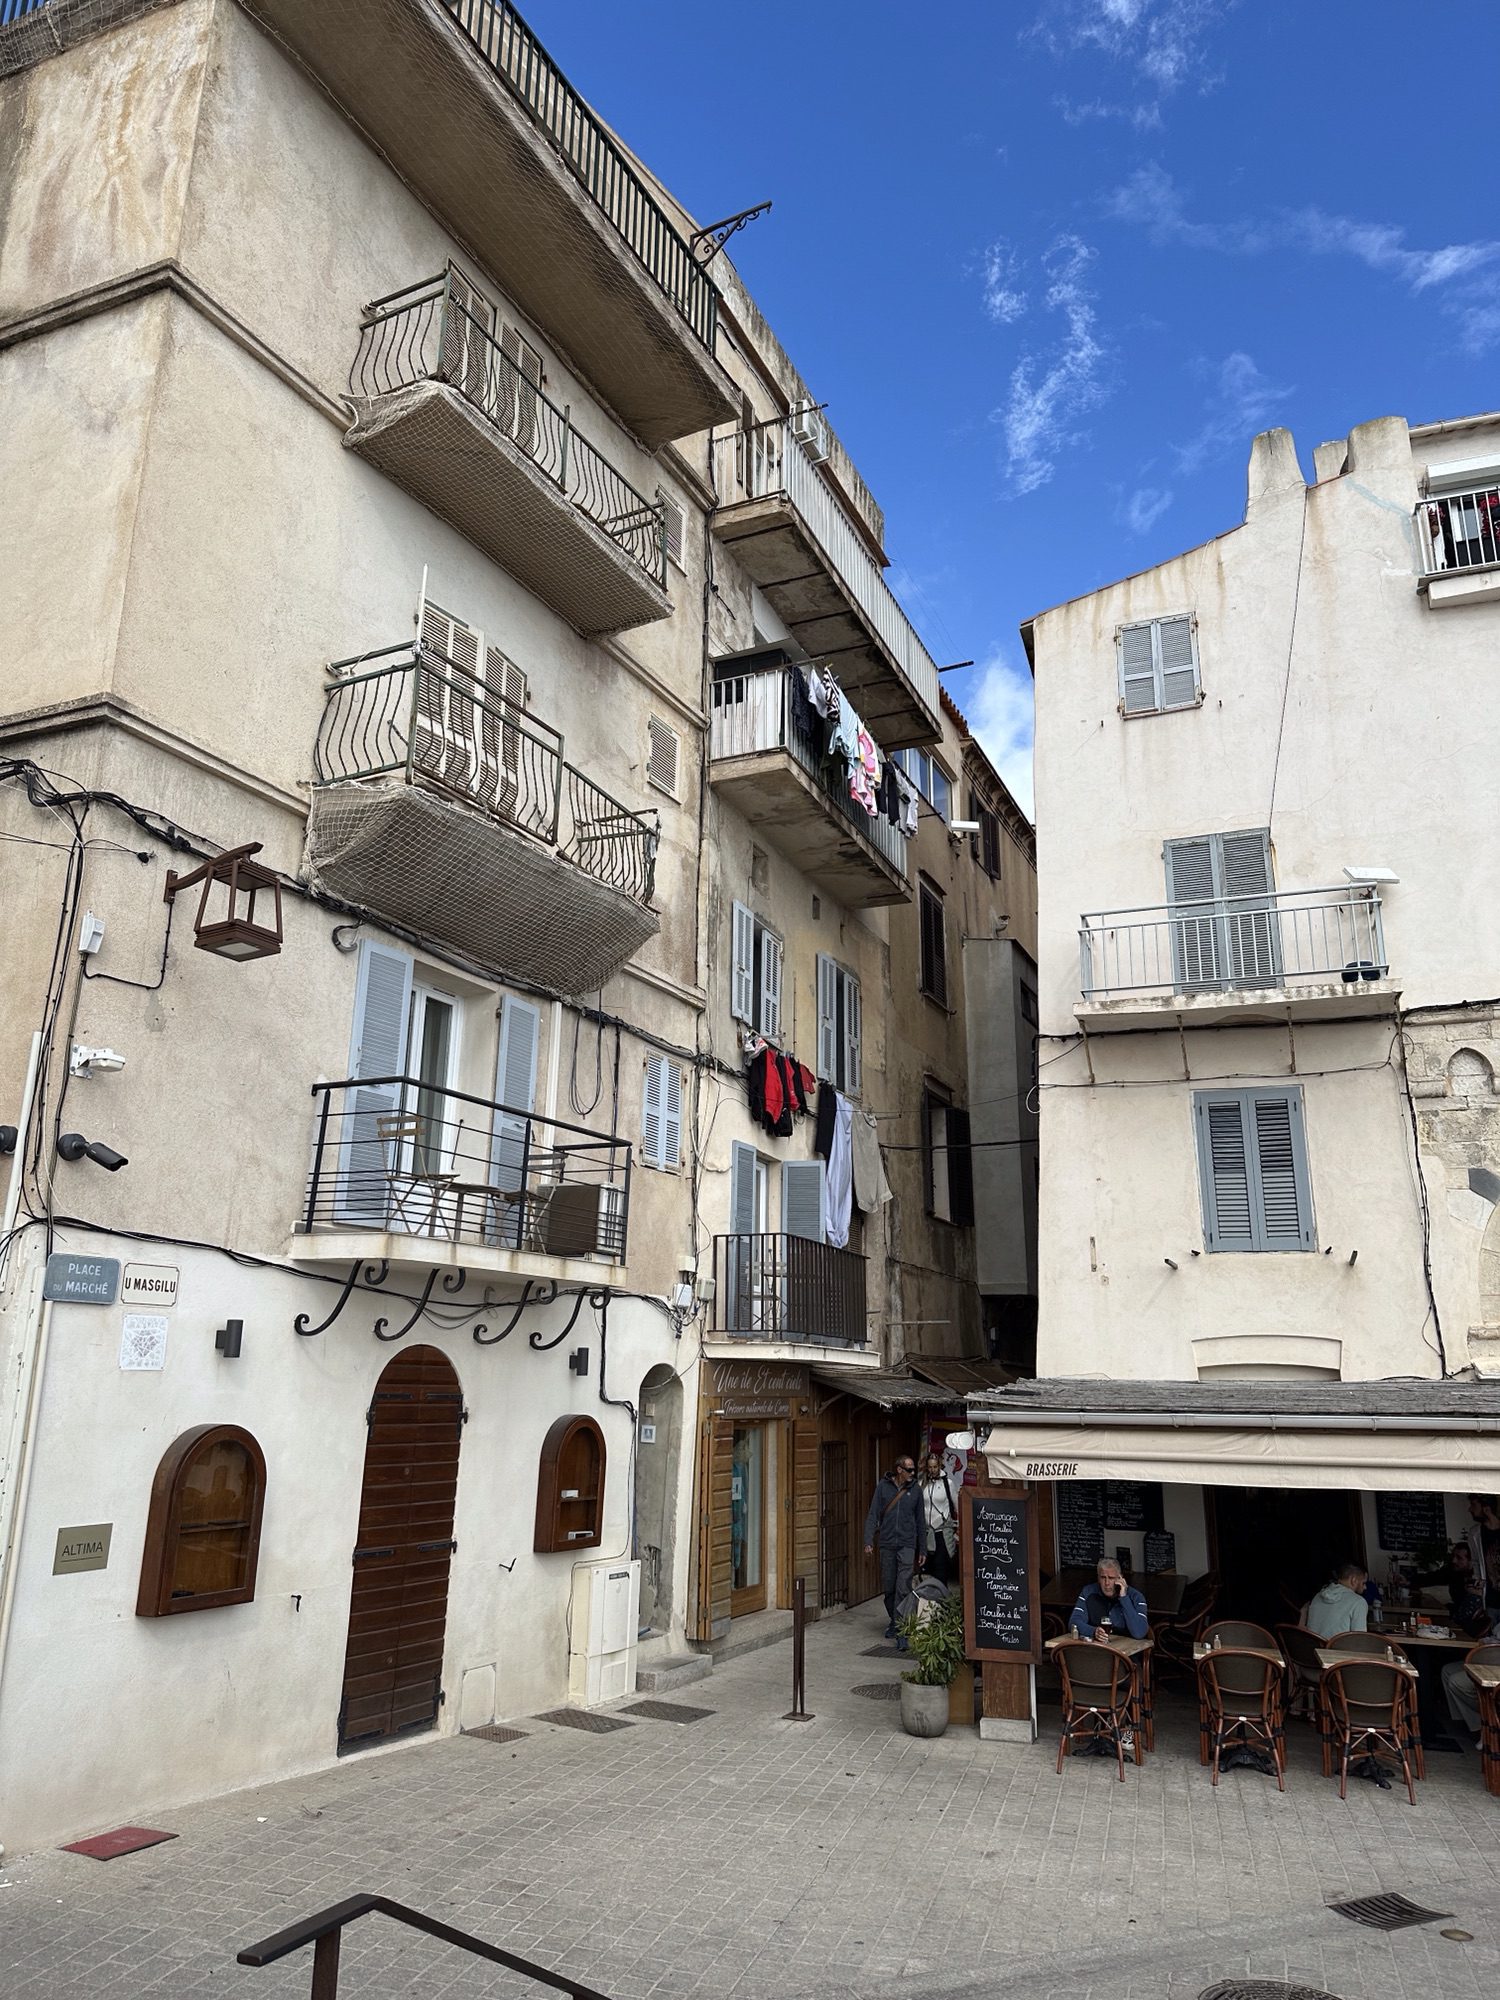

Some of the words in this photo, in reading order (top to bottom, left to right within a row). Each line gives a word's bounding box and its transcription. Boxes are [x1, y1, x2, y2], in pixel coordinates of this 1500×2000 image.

[68, 1263, 102, 1276] PLACE
[52, 1283, 63, 1292] DU
[65, 1280, 108, 1295] MARCHÉ
[124, 1277, 131, 1290] U
[133, 1278, 177, 1293] MASGILU
[713, 1362, 739, 1393] Une
[1026, 1463, 1079, 1476] BRASSERIE
[978, 1522, 987, 1532] de
[989, 1522, 1013, 1533] Moules
[974, 1534, 982, 1543] de
[1009, 1537, 1019, 1545] de
[62, 1541, 104, 1557] ALTIMA
[977, 1566, 1007, 1580] Moules
[994, 1591, 1013, 1600] Frites
[980, 1605, 1006, 1618] Moules
[1014, 1607, 1021, 1619] la
[1000, 1632, 1020, 1644] Frites
